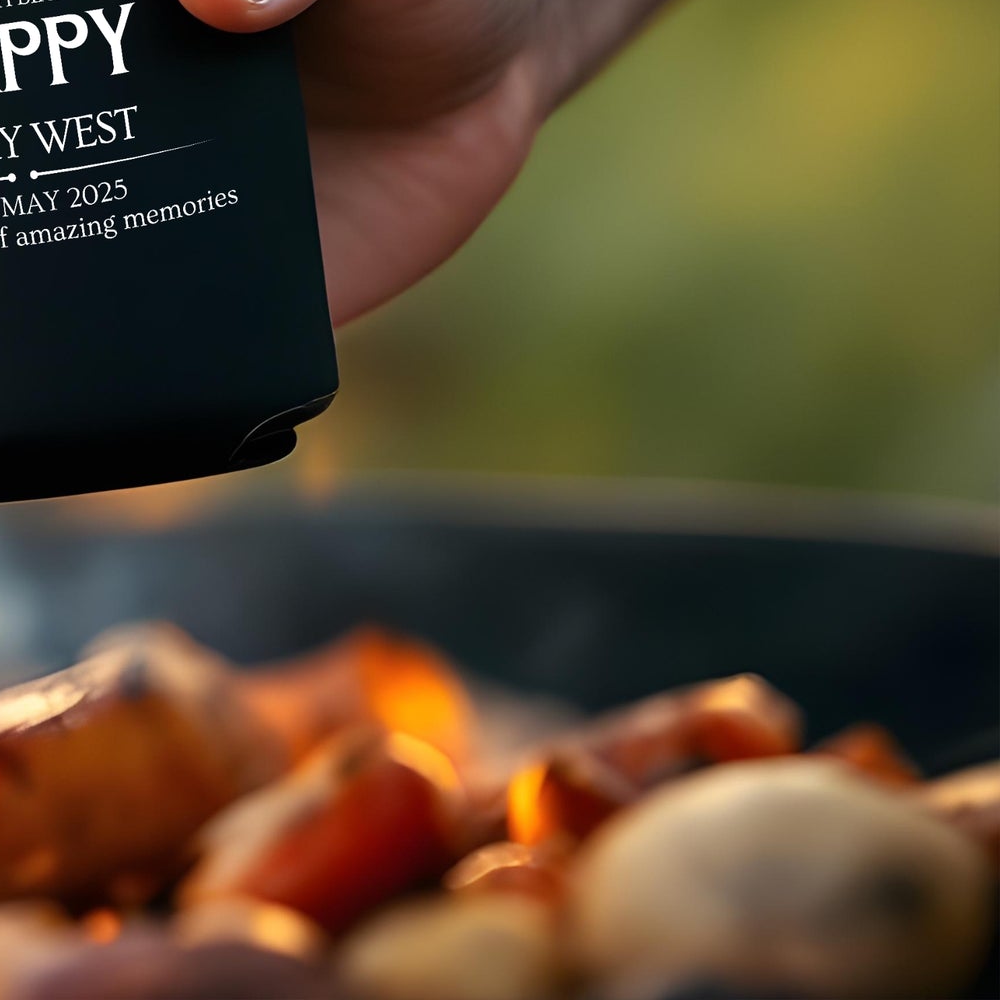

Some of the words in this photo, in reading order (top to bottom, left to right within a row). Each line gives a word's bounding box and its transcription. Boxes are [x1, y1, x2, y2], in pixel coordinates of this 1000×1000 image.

[29, 106, 137, 153] WEST
[1, 190, 59, 217] MAY
[67, 179, 127, 208] 2025
[16, 215, 117, 246] amazing
[123, 190, 238, 229] memories
